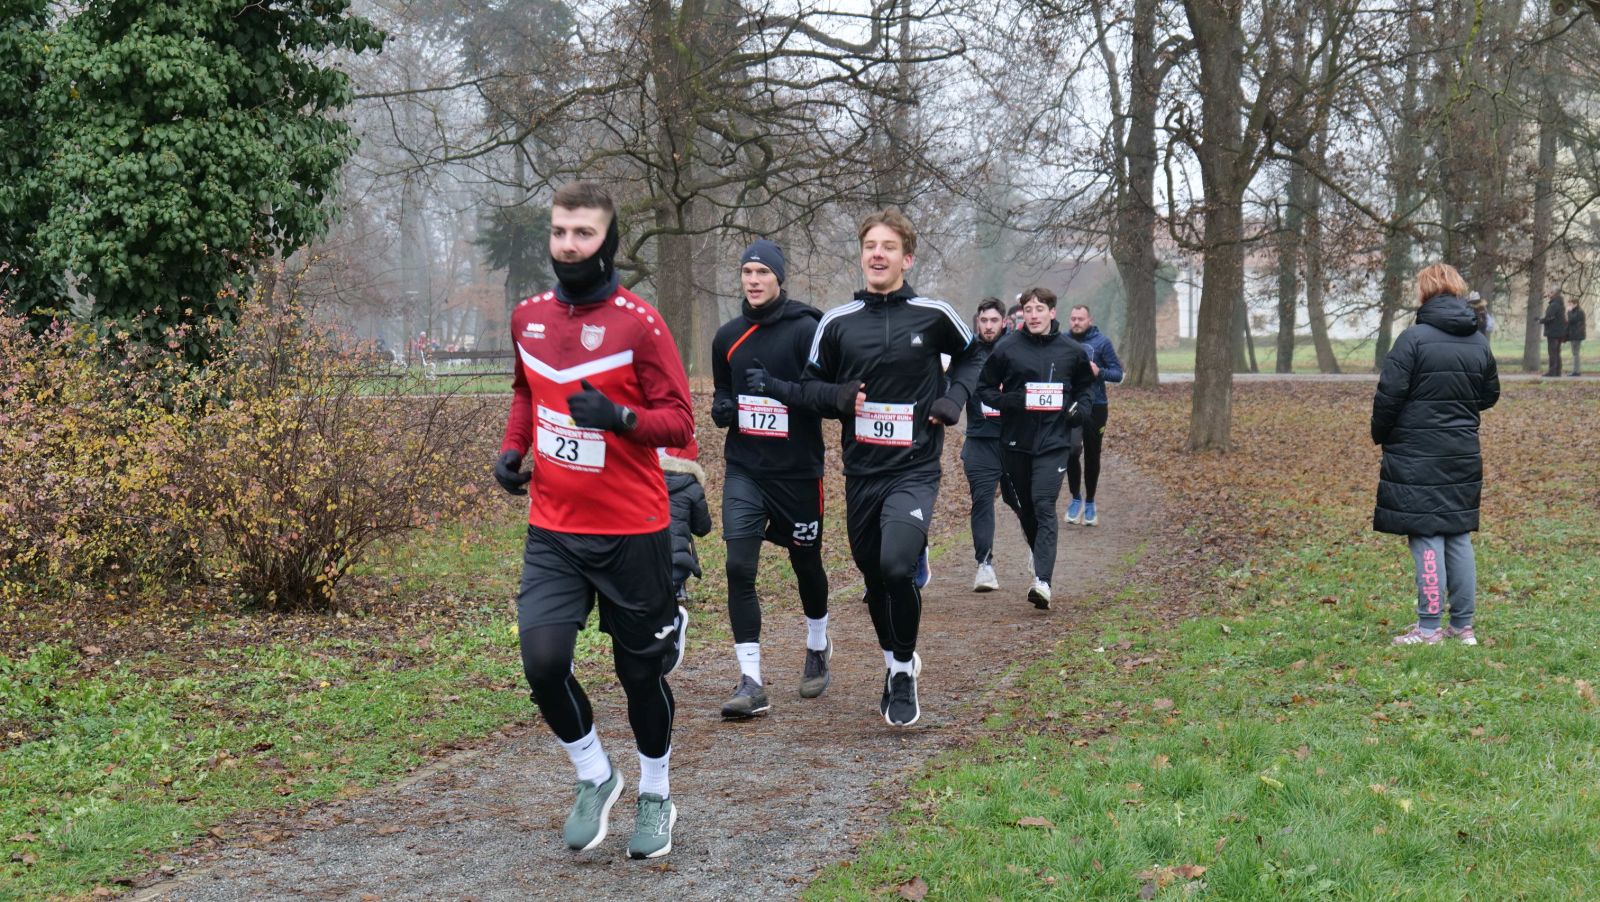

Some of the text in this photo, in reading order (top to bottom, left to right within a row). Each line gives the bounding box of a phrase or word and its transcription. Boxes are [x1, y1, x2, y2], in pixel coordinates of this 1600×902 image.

[1039, 394, 1053, 406] 64
[750, 412, 777, 430] 172
[873, 412, 896, 420] ADVENT
[873, 420, 895, 438] 99
[555, 437, 579, 462] 23
[792, 521, 819, 541] 23
[1422, 549, 1441, 615] adidas
